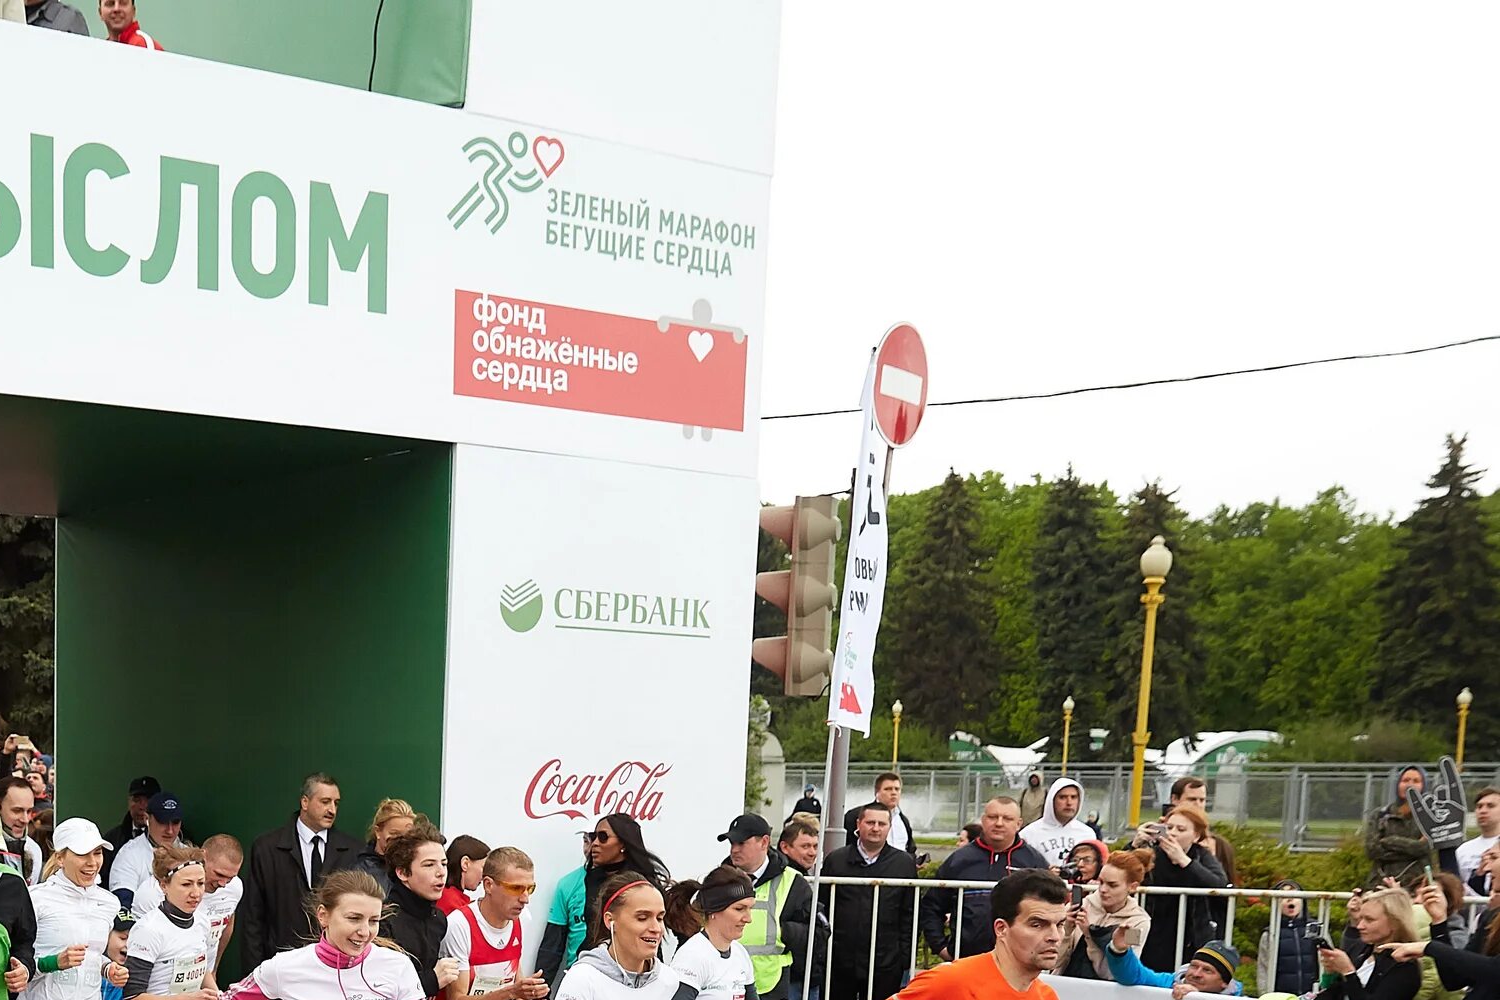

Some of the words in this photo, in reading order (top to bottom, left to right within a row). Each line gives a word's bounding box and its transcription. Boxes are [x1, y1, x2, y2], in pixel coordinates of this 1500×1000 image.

[546, 187, 650, 232] ЗЕЛЕНЫЙ
[658, 208, 757, 251] МАРАФОН
[545, 219, 645, 262] БЕГУЩИЕ
[653, 239, 733, 278] СЕРДЦА
[472, 293, 547, 336] фонд
[472, 326, 639, 375] обнажённые
[471, 358, 569, 393] сердца
[554, 587, 711, 629] СБЕРБАНК
[524, 759, 674, 821] Coca-Cola
